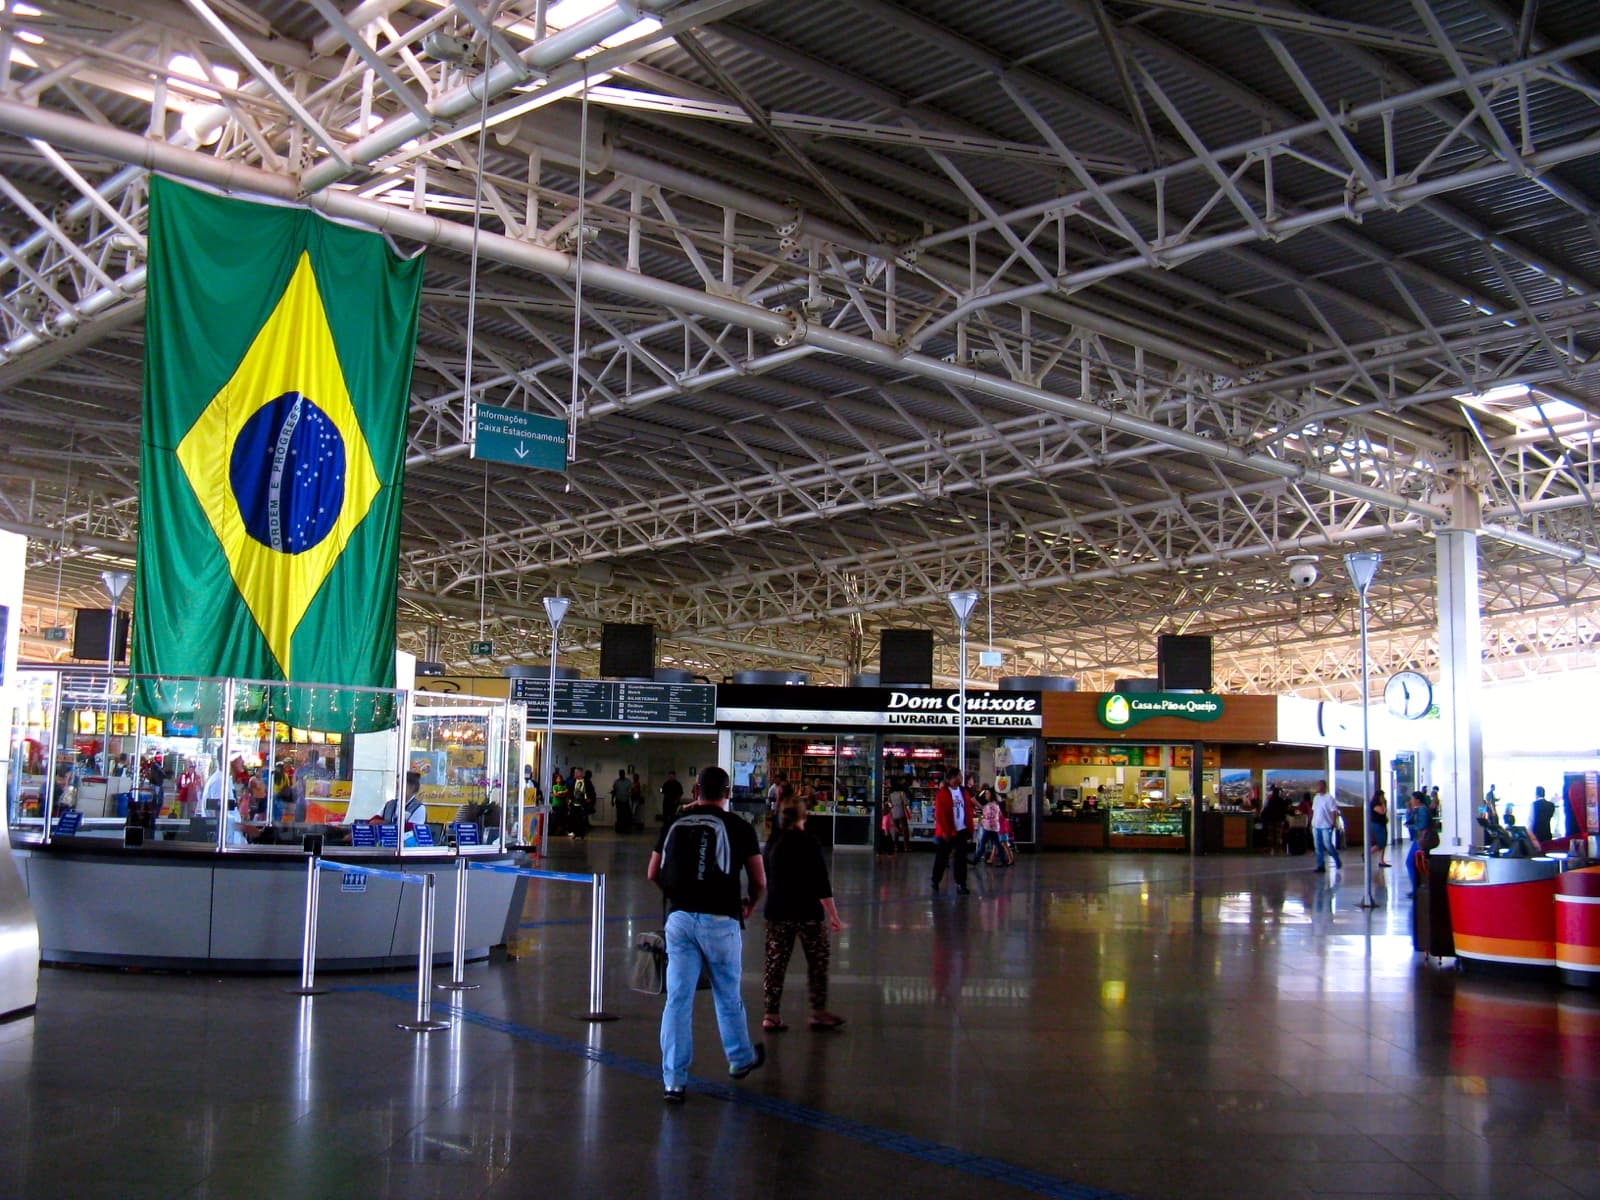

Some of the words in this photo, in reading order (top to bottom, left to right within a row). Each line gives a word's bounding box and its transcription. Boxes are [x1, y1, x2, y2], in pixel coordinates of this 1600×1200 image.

[478, 409, 528, 425] Informações
[478, 422, 501, 433] Caixa
[503, 426, 566, 444] Estacionamento
[271, 481, 280, 489] E
[270, 500, 280, 546] ORDEM
[887, 692, 943, 710] Dom
[946, 692, 1037, 712] Quixote
[1131, 700, 1152, 710] Casa
[1161, 700, 1178, 710] Pão
[1186, 700, 1218, 713] Queijo
[888, 714, 948, 726] LIVRARIA
[952, 716, 960, 726] E
[964, 716, 1033, 727] PAPELARIA
